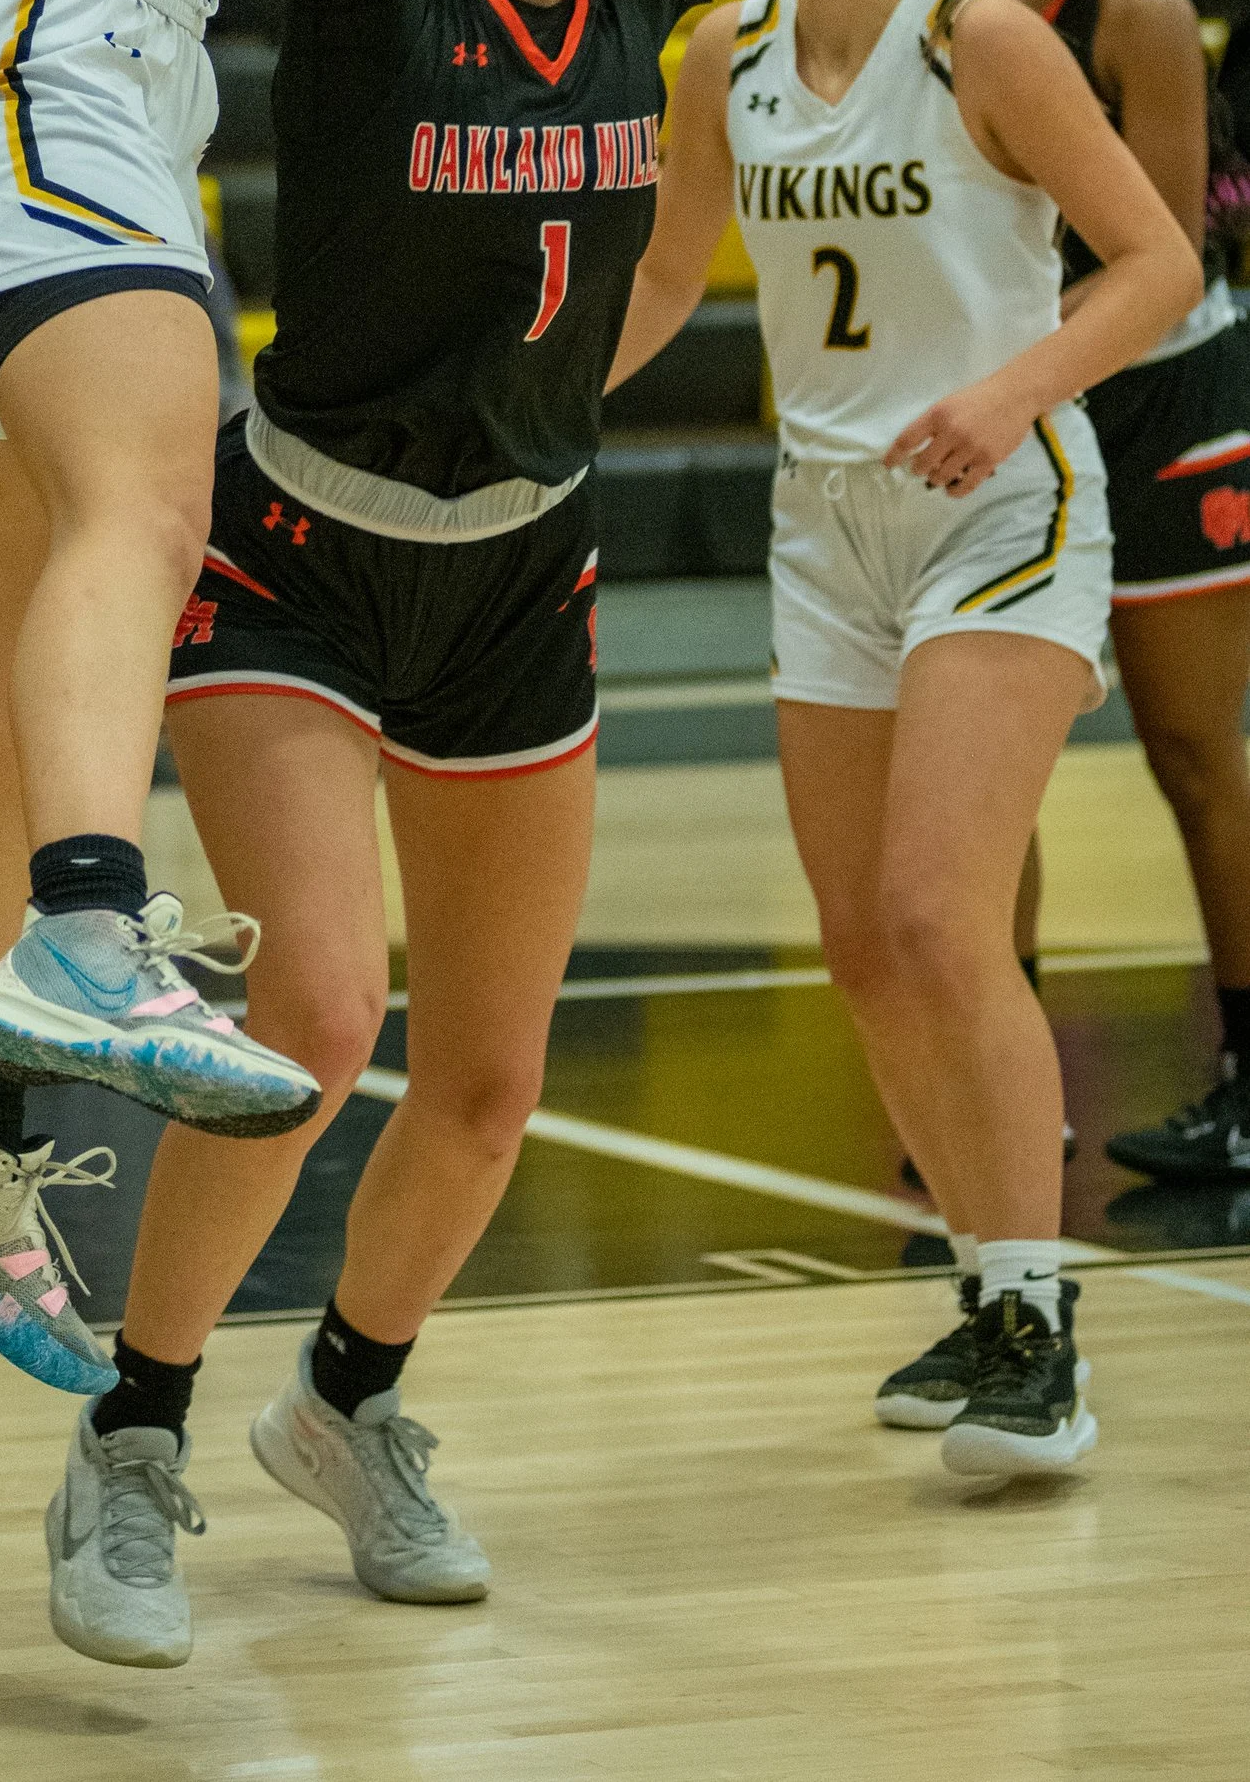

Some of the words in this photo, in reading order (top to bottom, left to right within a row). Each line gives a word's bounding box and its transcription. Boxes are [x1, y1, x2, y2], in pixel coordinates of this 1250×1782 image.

[408, 121, 586, 194] OAKLAND
[738, 159, 934, 221] VIKINGS
[523, 220, 572, 343] 1
[810, 243, 872, 352] 2
